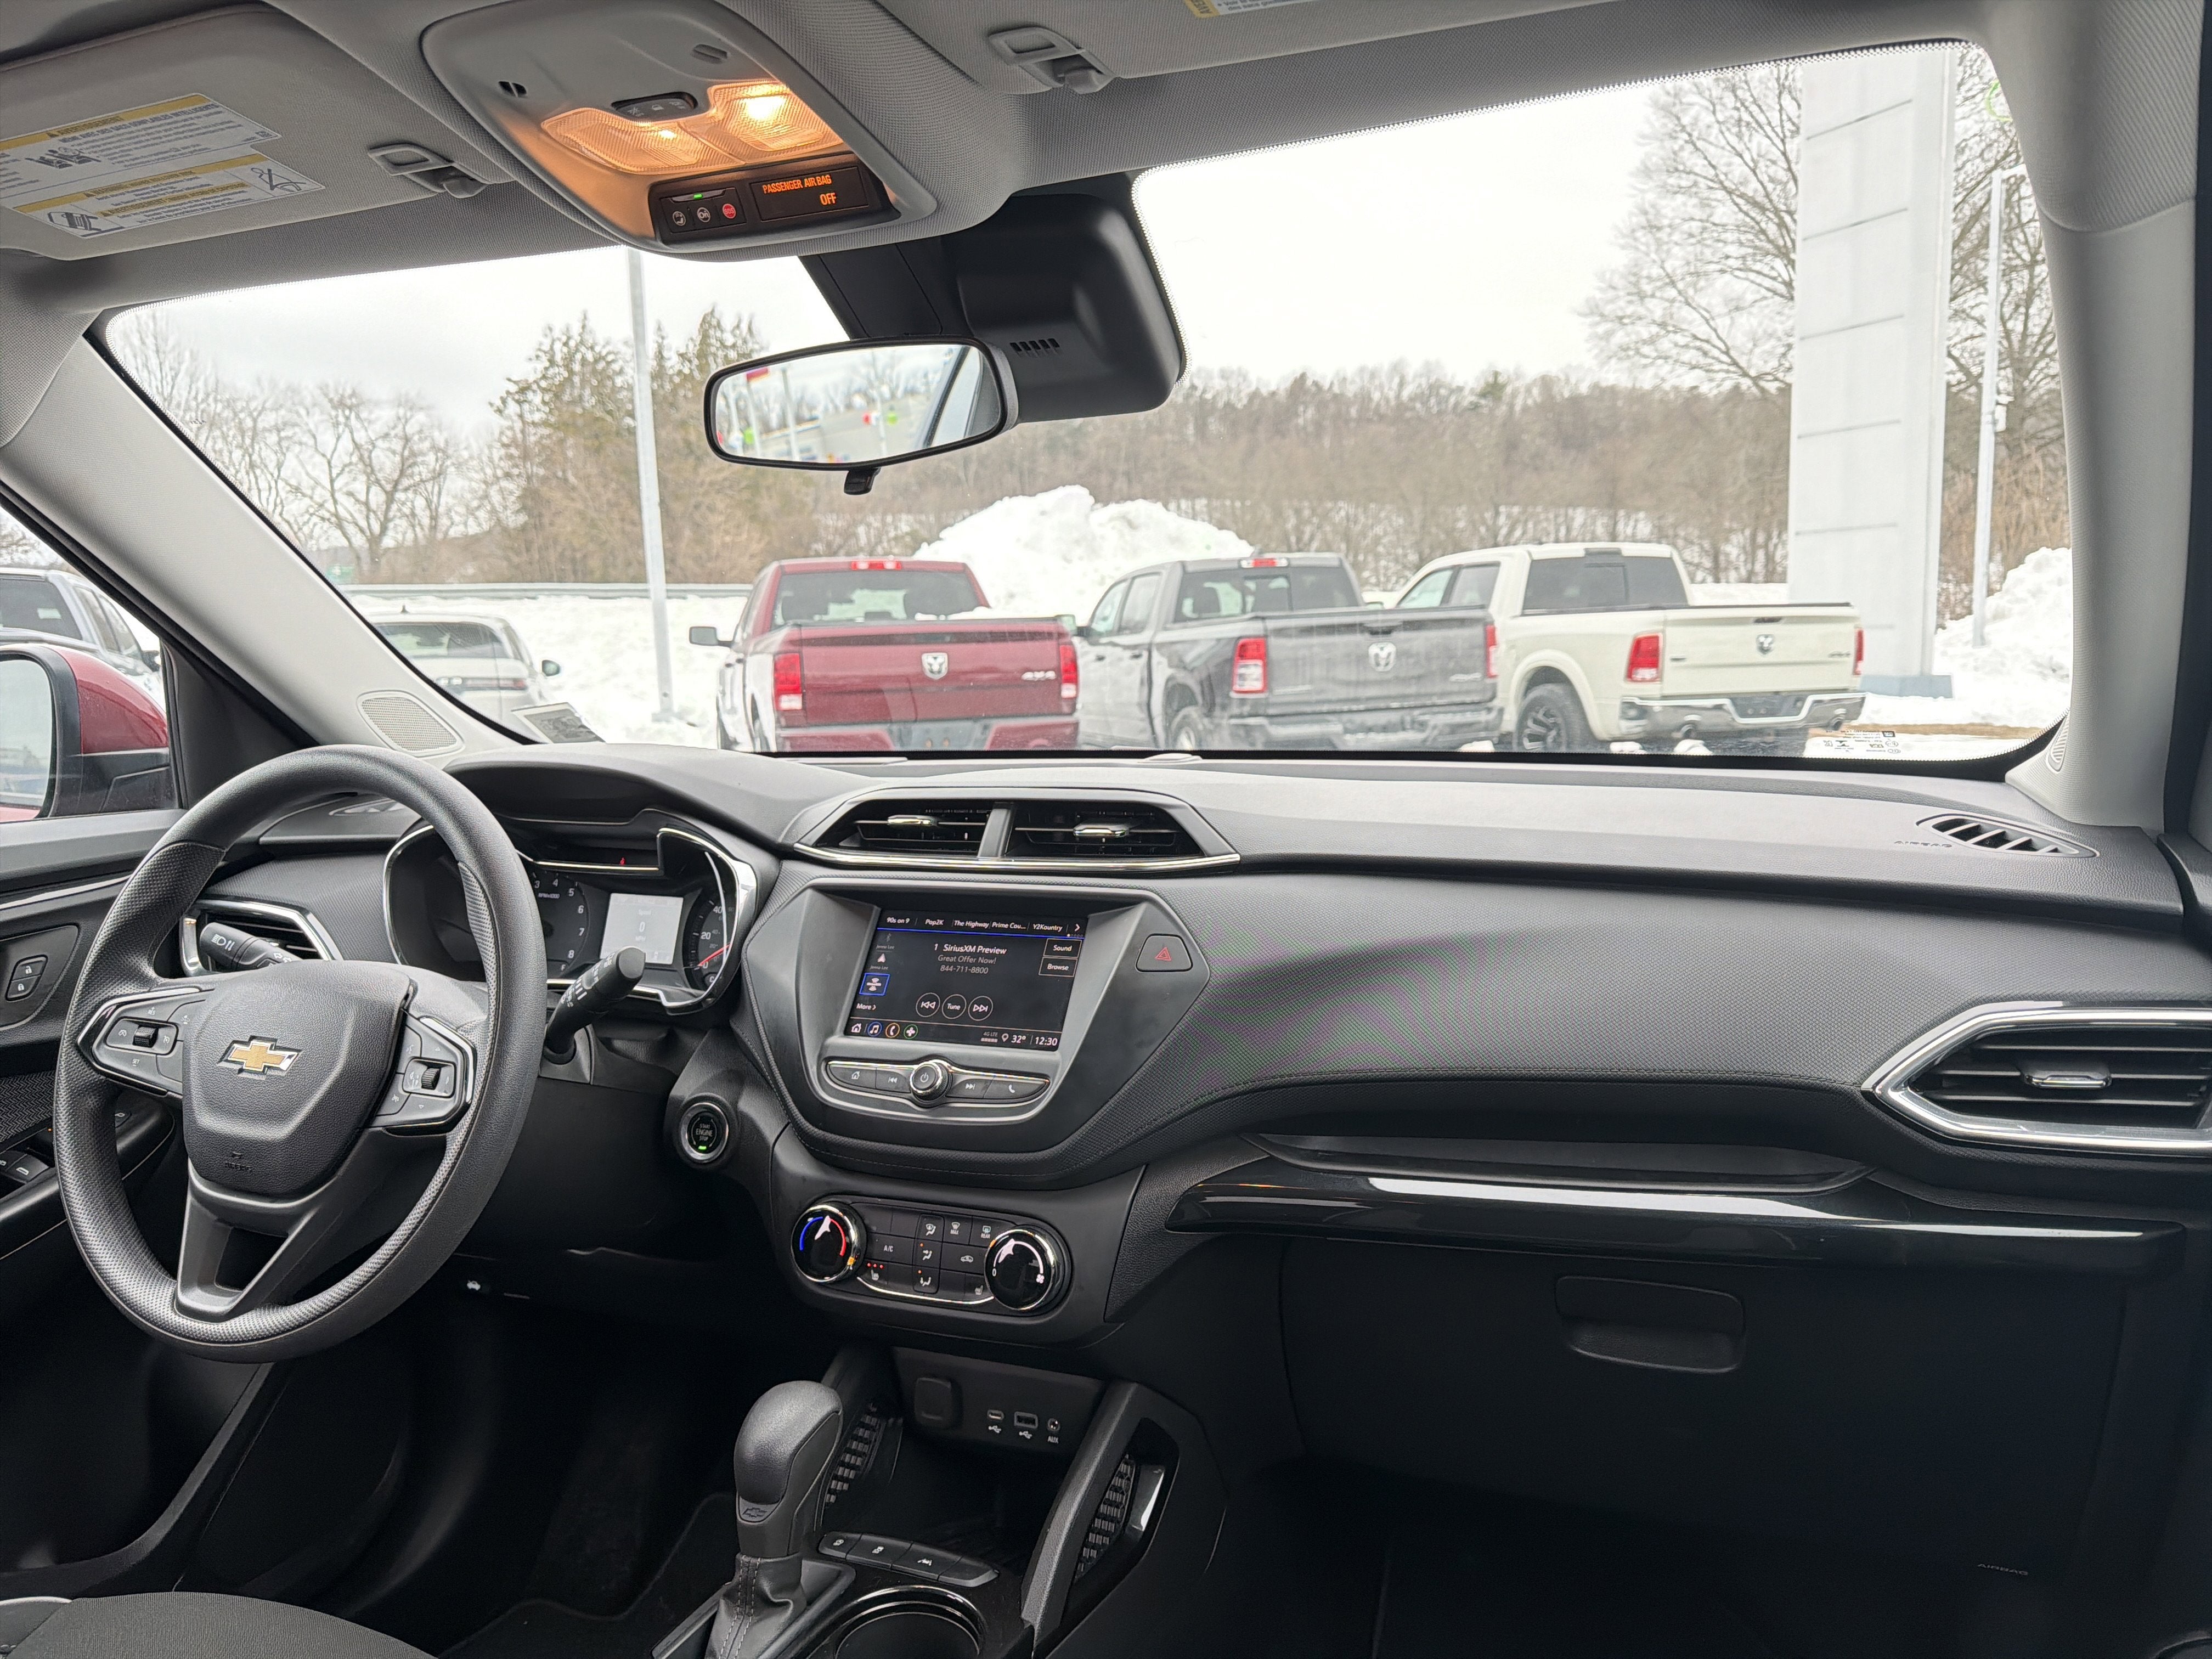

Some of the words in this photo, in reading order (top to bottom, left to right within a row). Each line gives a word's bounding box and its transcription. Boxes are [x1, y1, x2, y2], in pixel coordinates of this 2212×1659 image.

[763, 180, 803, 194] PASSENGER
[804, 177, 816, 188] AIR
[816, 174, 832, 185] BAG
[820, 193, 837, 205] OFF
[534, 880, 540, 889] 3
[568, 888, 575, 896] 5
[578, 905, 584, 913] 6
[639, 921, 646, 932] 0
[1032, 924, 1063, 932] Y2Kountry
[579, 928, 585, 936] 7
[701, 932, 711, 940] 20
[943, 944, 977, 952] SiriusXM
[977, 945, 1007, 955] Preview
[568, 950, 574, 958] 8
[958, 955, 977, 963] Offer
[940, 965, 989, 974] 844-711-8800
[1011, 1035, 1026, 1043] 32°
[1035, 1036, 1058, 1046] 12:30
[883, 1245, 894, 1253] A/C
[1047, 1436, 1059, 1444] AUX
[1977, 1564, 2029, 1576] AIRBAG
